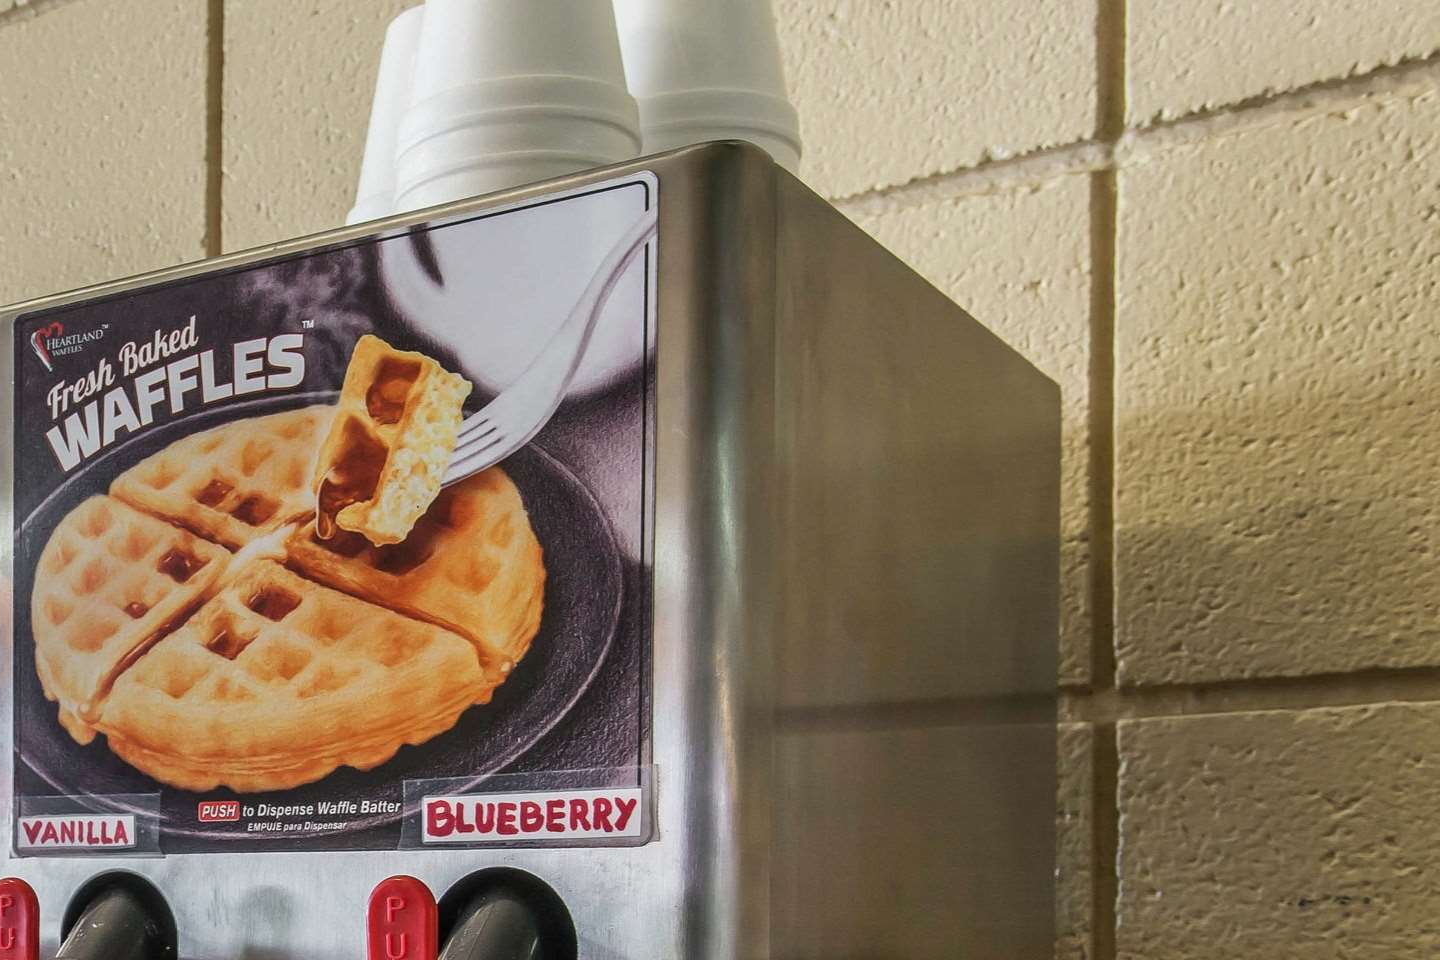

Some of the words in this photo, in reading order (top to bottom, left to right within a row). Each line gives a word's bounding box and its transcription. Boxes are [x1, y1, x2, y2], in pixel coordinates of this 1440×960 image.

[46, 329, 104, 351] HEARTLAND
[46, 357, 116, 420] Fresh
[118, 314, 199, 377] Baked
[46, 333, 306, 473] WAFFLES
[201, 804, 238, 819] PUSH
[242, 804, 255, 817] to
[257, 803, 314, 819] Dispense
[317, 800, 357, 815] Waffle
[360, 800, 402, 815] Batter
[426, 797, 638, 838] BLUEBERRY
[22, 820, 129, 845] VANILLA
[247, 822, 283, 832] EMPUJE
[283, 823, 302, 833] para
[304, 821, 348, 832] Dispensar
